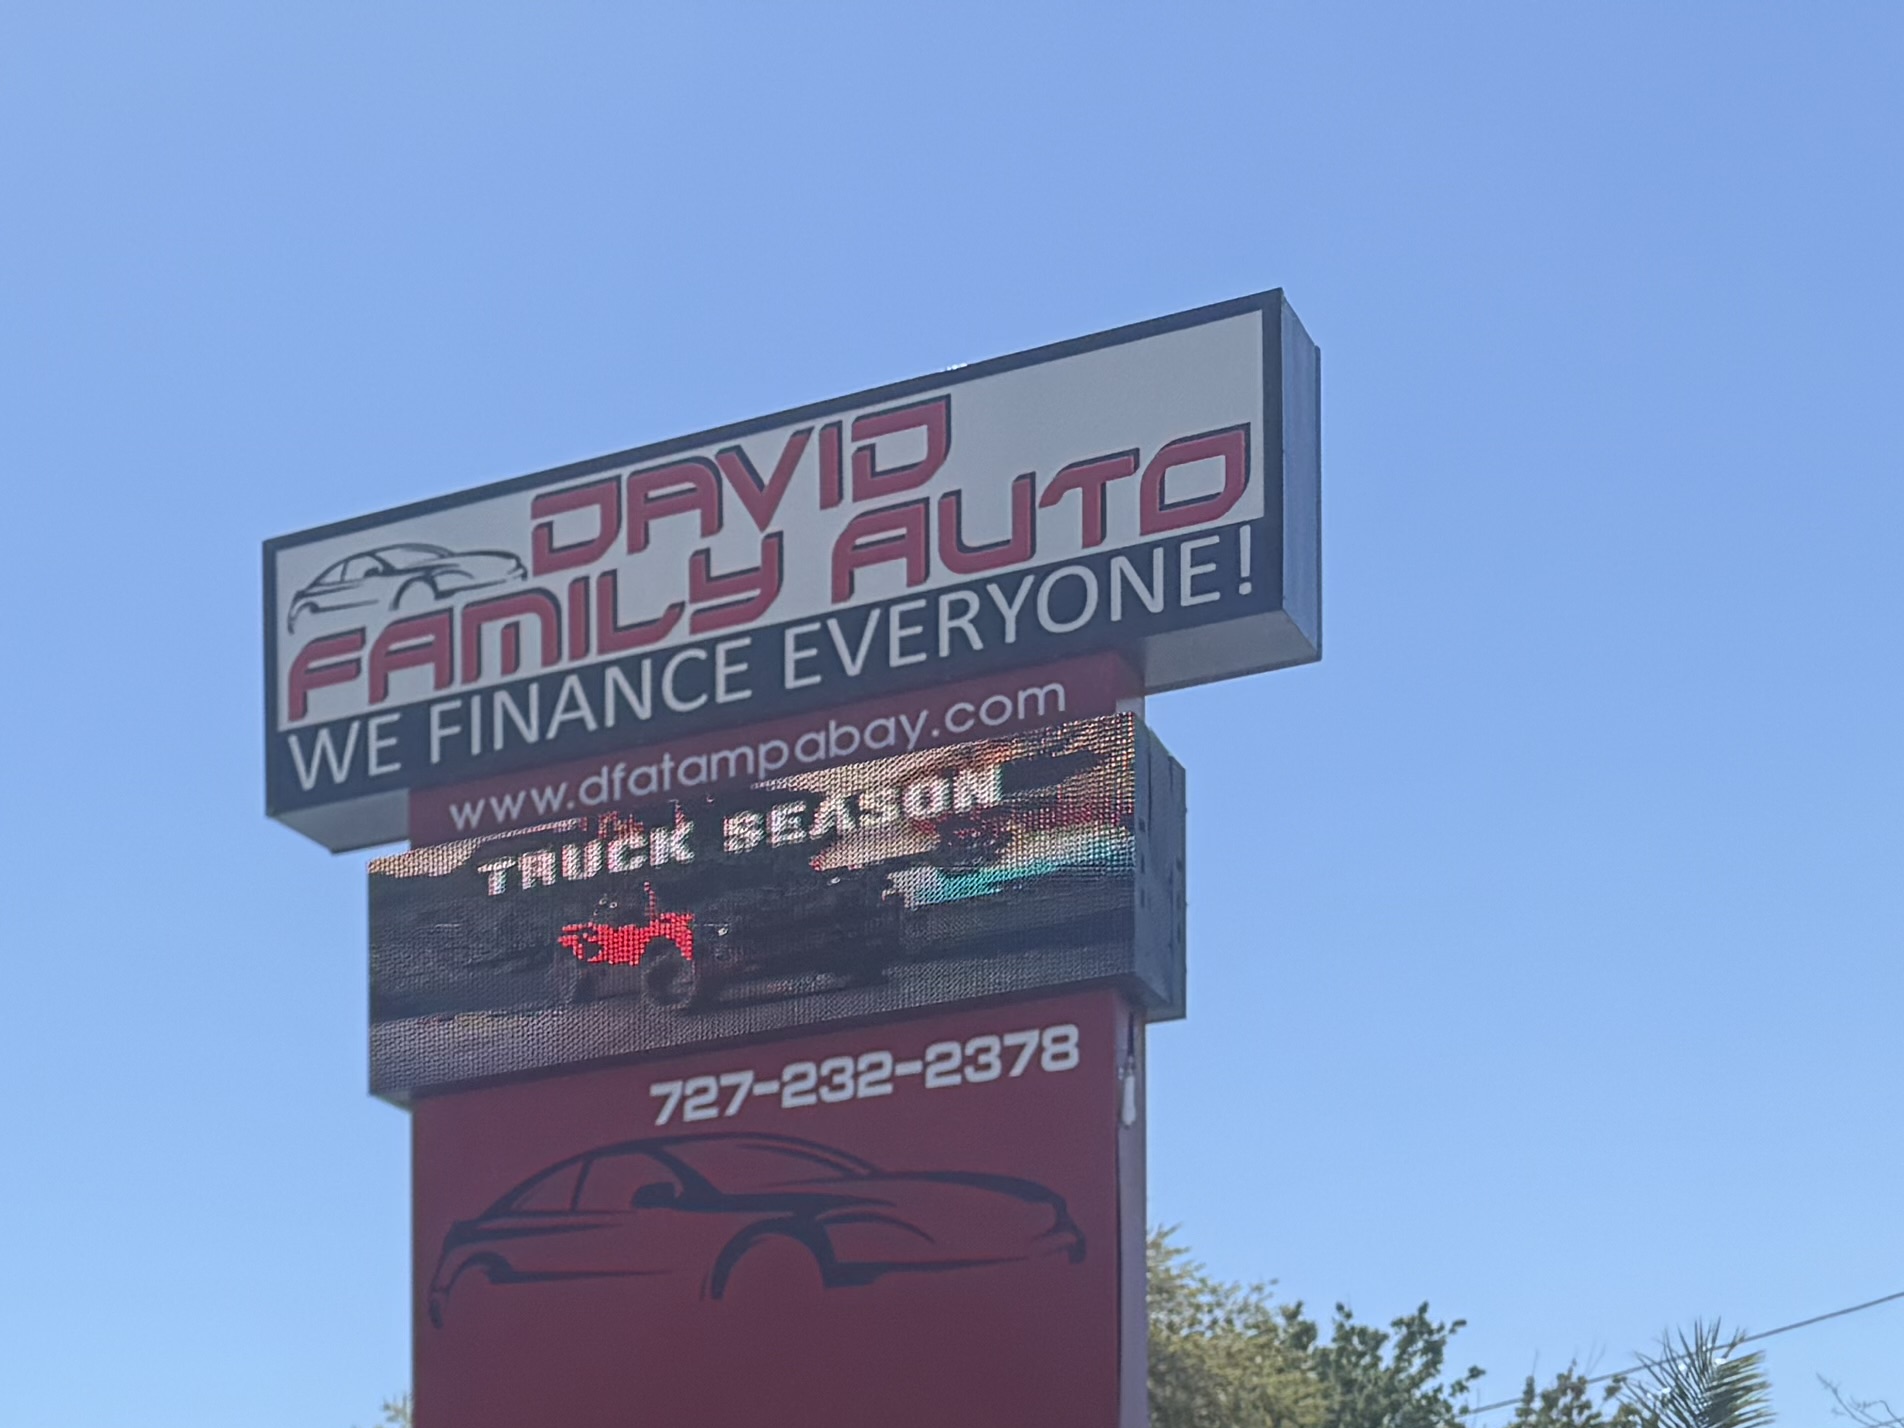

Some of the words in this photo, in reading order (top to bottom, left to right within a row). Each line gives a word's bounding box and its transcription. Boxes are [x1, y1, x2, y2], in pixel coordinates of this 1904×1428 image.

[530, 393, 952, 572] DAVID
[288, 534, 784, 720] FAMILY
[831, 422, 1252, 602] AUTO
[288, 712, 401, 791] WE
[428, 638, 752, 764] FINANCE
[784, 535, 1255, 691] EVERYONE!
[448, 678, 1067, 831] www.dfatampabay.com
[476, 825, 696, 897] TRUCK
[723, 764, 1005, 854] SEASON
[649, 1023, 1081, 1127] 727-232-2378
